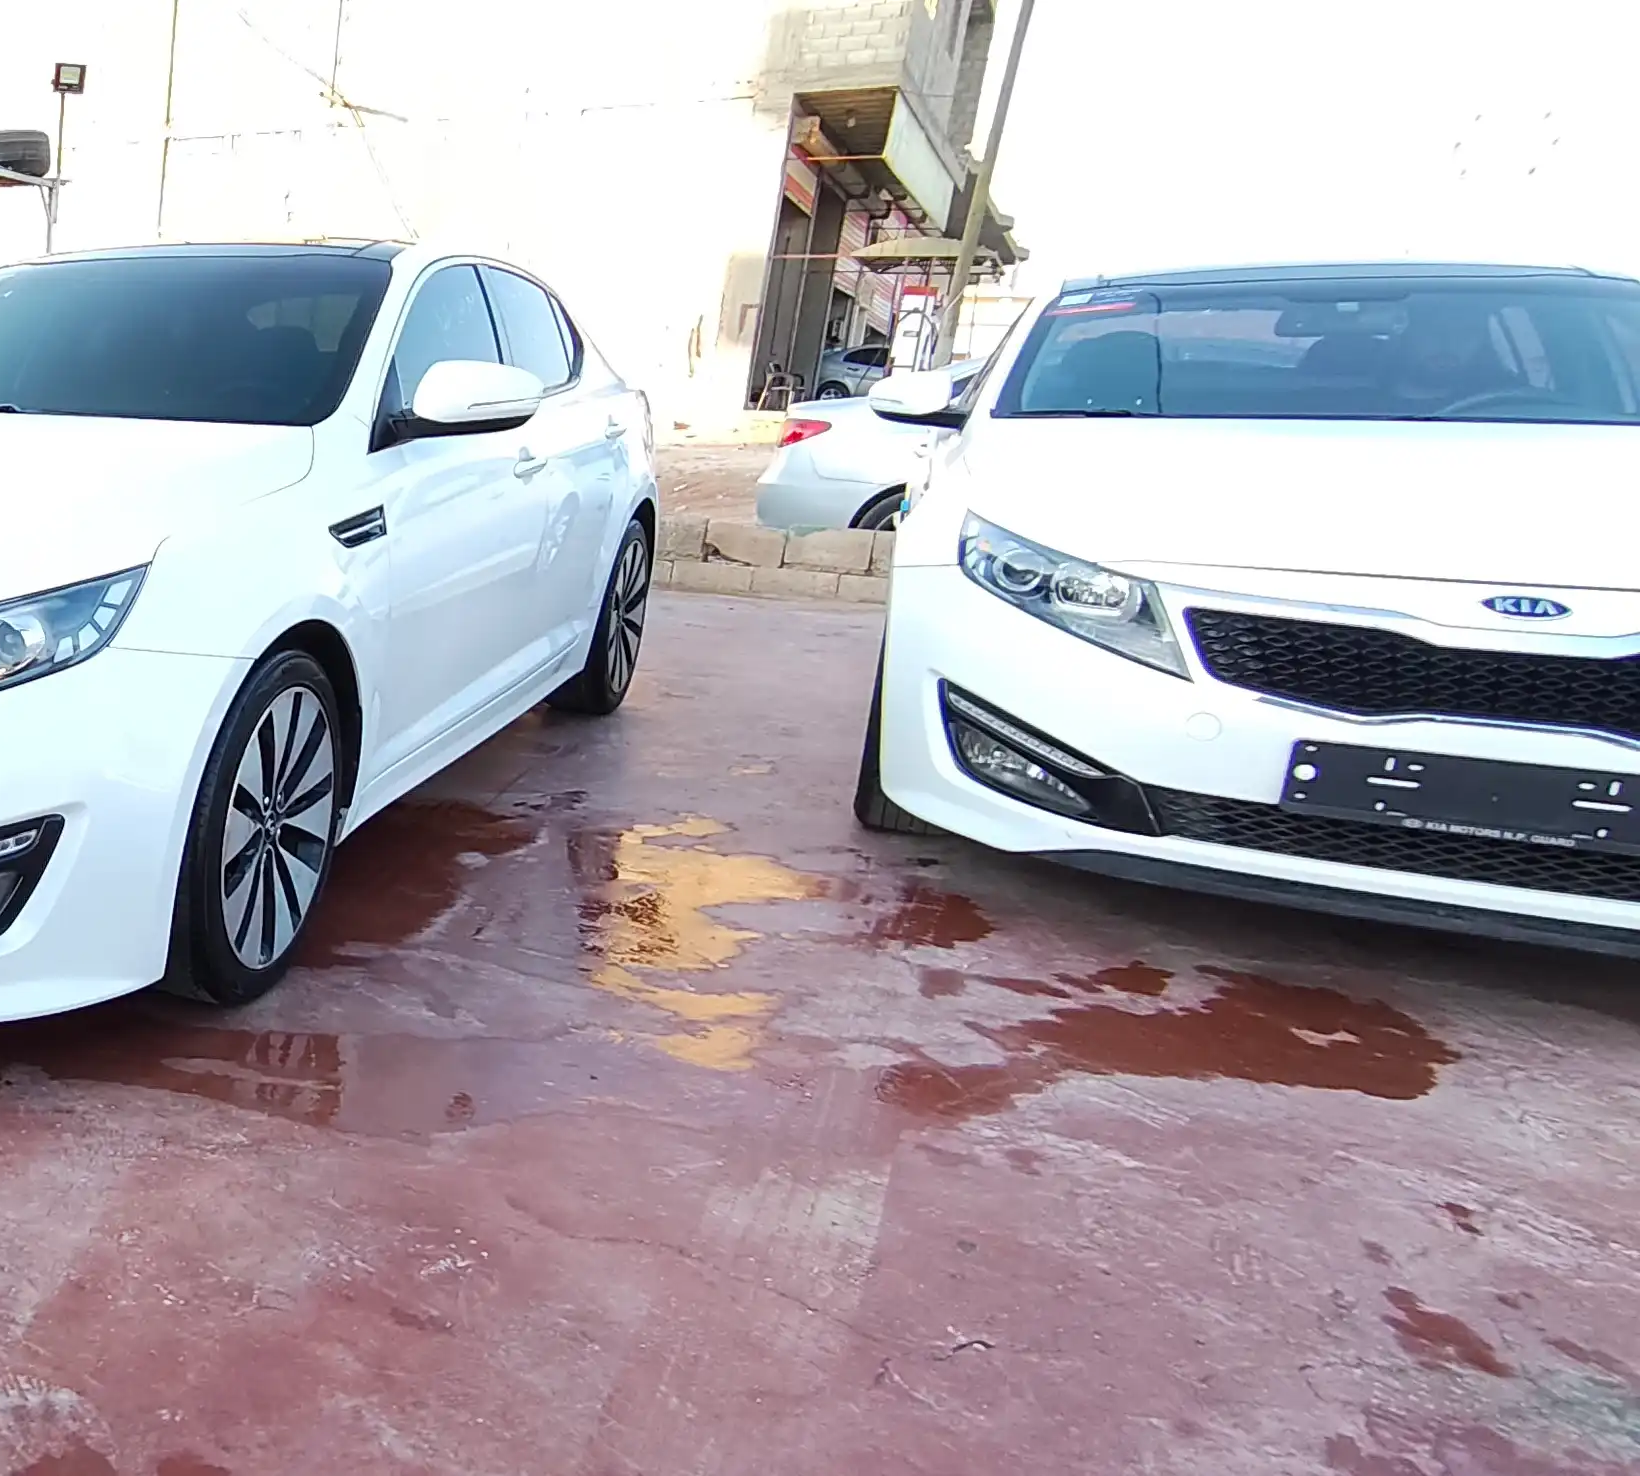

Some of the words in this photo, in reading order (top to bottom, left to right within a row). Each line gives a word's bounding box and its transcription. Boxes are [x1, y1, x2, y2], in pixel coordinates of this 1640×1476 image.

[1494, 598, 1560, 615] KIA
[1448, 825, 1501, 838] MOTORS
[1530, 834, 1576, 847] GUARD
